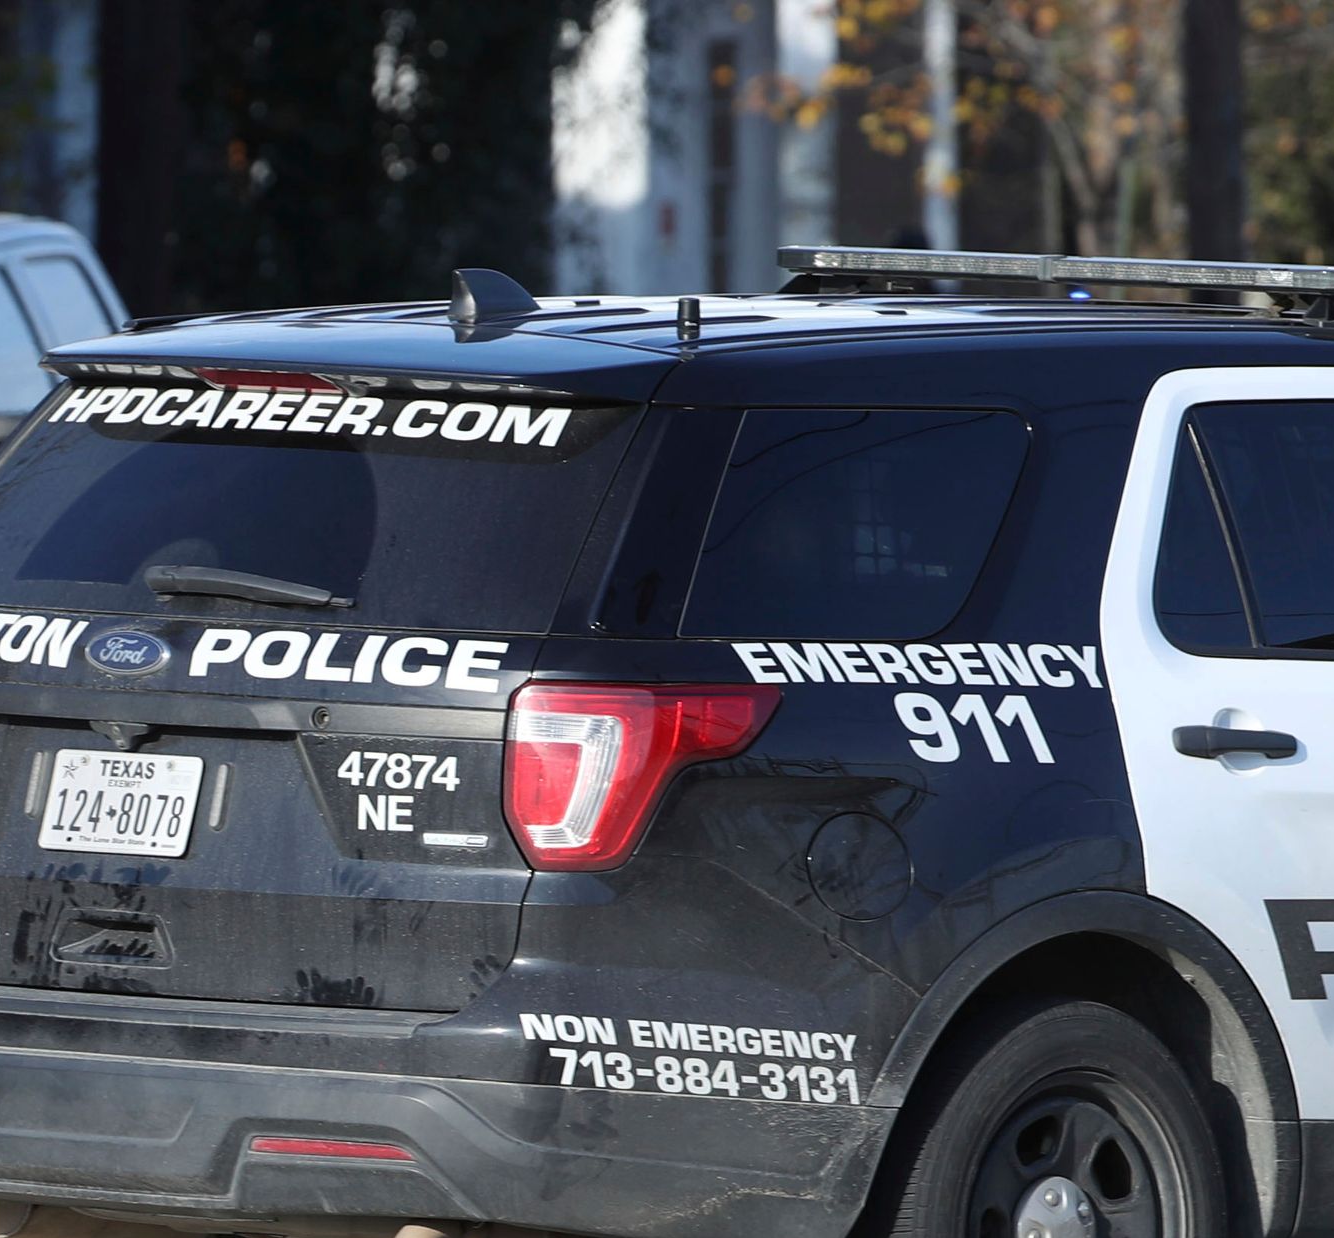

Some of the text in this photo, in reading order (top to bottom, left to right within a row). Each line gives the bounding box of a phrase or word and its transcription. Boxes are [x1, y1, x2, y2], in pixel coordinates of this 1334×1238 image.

[48, 386, 571, 447] HPDCAREER.COM
[99, 636, 148, 664] Ford
[189, 628, 510, 694] POLICE
[731, 642, 1105, 688] EMERGENCY
[893, 692, 1055, 764] 911
[100, 759, 156, 780] TEXAS
[337, 751, 460, 791] 47874
[357, 794, 415, 832] NE
[519, 1013, 857, 1062] NON EMERGENCY
[548, 1047, 861, 1105] 713-884-3131
